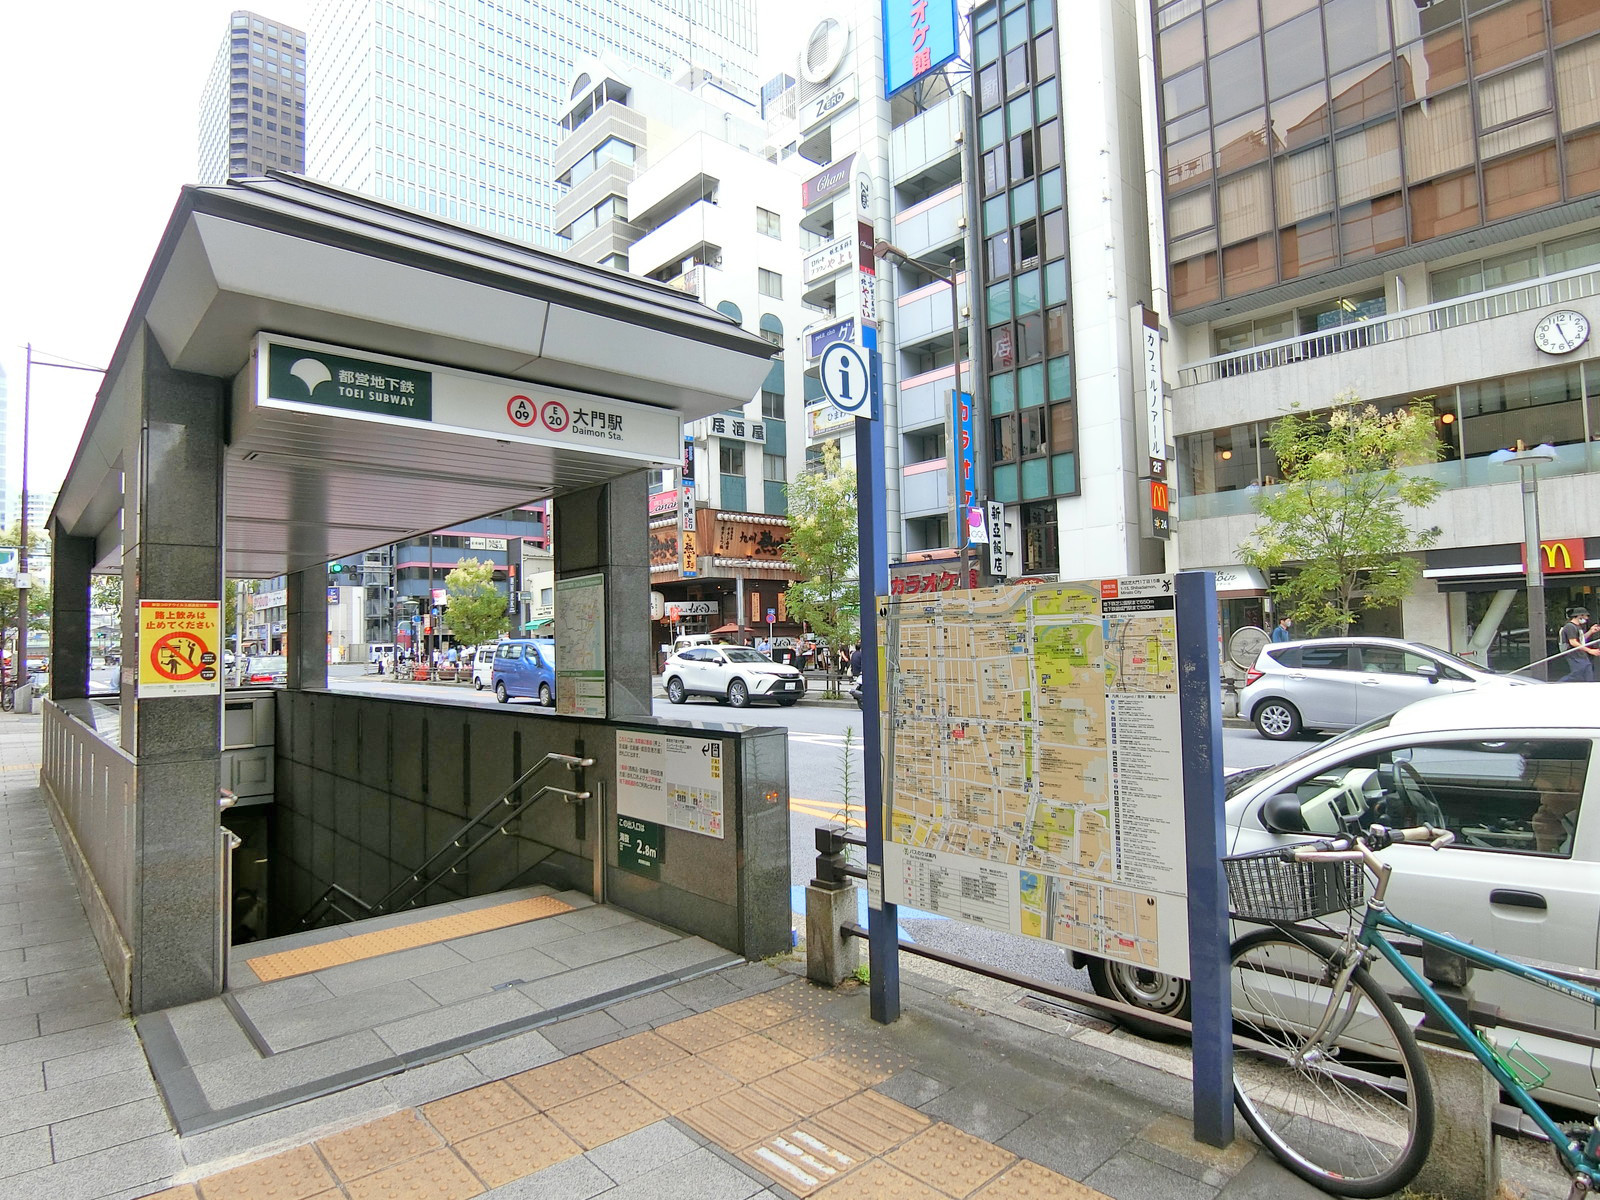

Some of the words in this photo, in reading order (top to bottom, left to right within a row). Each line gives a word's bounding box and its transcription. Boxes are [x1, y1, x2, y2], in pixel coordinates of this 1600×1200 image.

[911, 0, 931, 78] オケ館
[338, 369, 415, 394] 都営地下鉄
[338, 386, 364, 399] TOEI
[369, 391, 414, 407] SUBWAY
[1147, 333, 1160, 454] カフェルノアール
[518, 400, 526, 410] A
[553, 406, 558, 415] E
[515, 410, 529, 421] 09
[548, 415, 562, 426] 20
[573, 408, 623, 431] 大門駅
[572, 425, 606, 439] Daimon
[608, 431, 624, 441] Sta.
[712, 417, 765, 441] 居酒屋
[1153, 461, 1162, 473] 2F
[1161, 519, 1168, 530] 24
[154, 611, 206, 620] 路上飲みは
[146, 621, 215, 630] 止めてください
[636, 839, 657, 859] 2.8m
